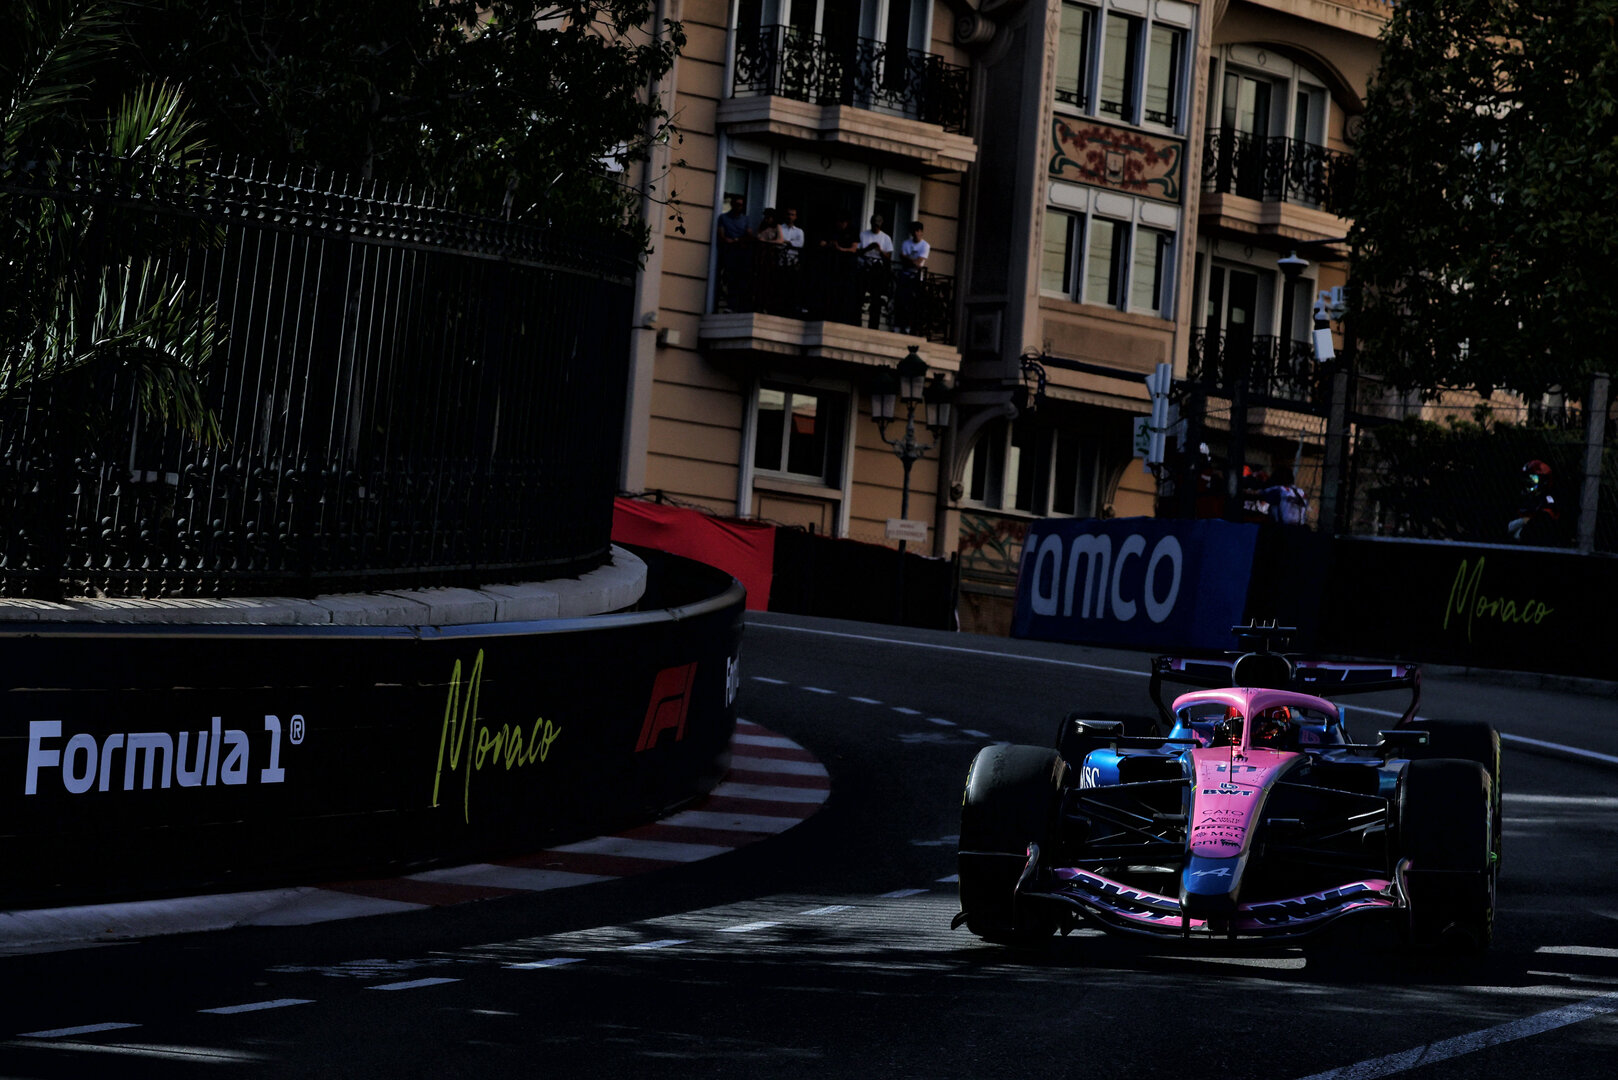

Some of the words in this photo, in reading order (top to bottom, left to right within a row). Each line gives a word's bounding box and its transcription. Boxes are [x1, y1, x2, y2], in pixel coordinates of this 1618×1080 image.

[1443, 555, 1556, 645] Monaco
[24, 716, 249, 796] Formula
[433, 648, 562, 825] Monaco
